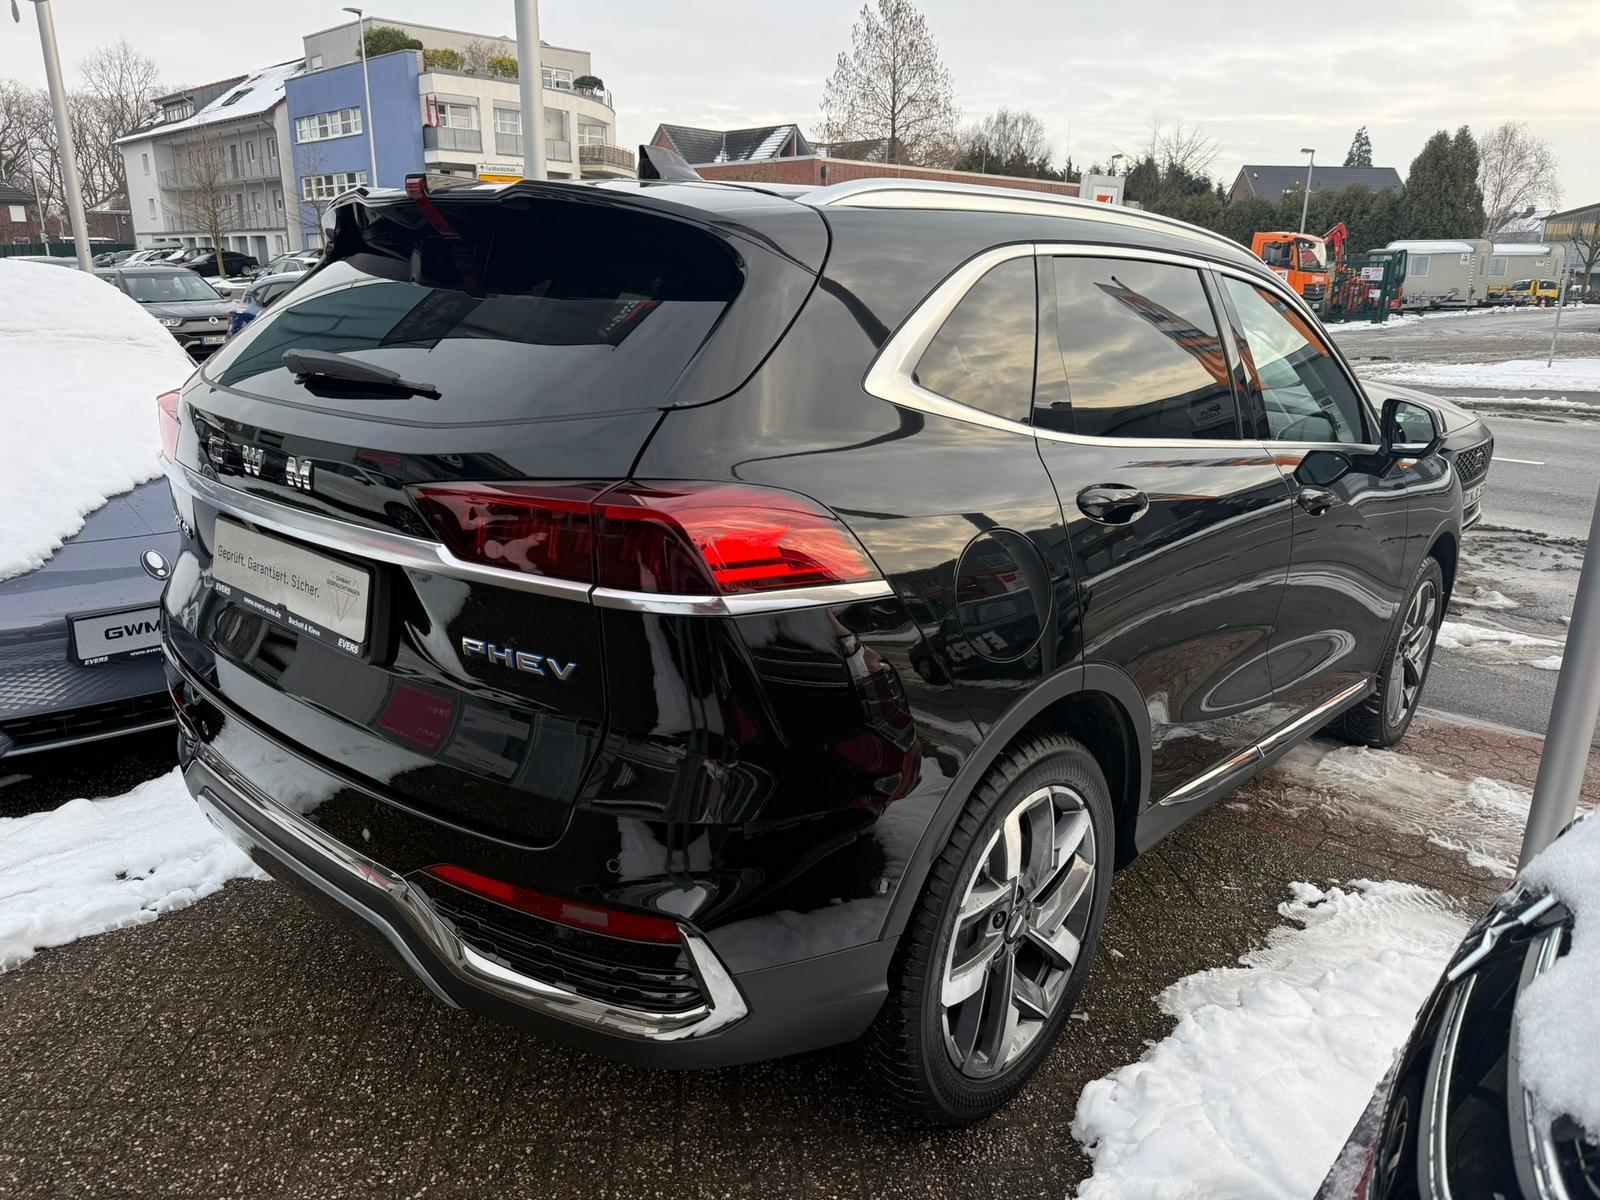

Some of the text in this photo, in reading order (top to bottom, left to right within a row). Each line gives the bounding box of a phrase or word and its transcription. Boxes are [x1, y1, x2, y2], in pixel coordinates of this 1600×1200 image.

[217, 544, 320, 599] Geprüft. Garantiert. Sicher.
[215, 582, 231, 596] EVERS
[104, 619, 160, 640] GWM
[337, 638, 359, 654] EVERS
[84, 655, 109, 666] EVERS
[462, 636, 577, 680] PHEV
